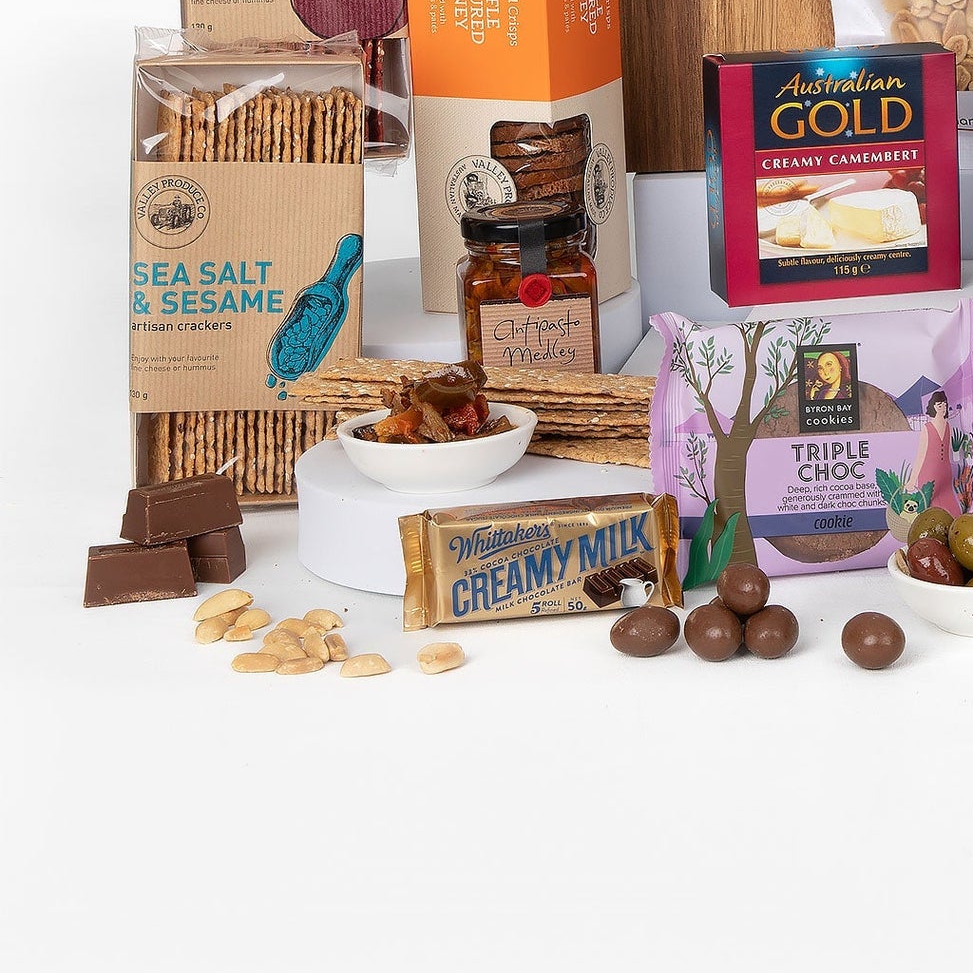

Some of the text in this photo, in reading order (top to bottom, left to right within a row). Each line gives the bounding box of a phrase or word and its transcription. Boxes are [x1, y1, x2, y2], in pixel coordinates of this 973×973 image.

[439, 5, 447, 25] with
[506, 6, 520, 47] Crisps
[775, 67, 906, 99] Australian
[770, 96, 913, 141] GOLD
[761, 149, 919, 171] CREAMY CAMEMBERT
[471, 159, 509, 184] VALLEY
[137, 178, 205, 220] VALLEY PRODUCE
[778, 251, 911, 268] Subtle flavour, deliciously creamy centre.
[133, 261, 273, 287] SEA SALT
[833, 265, 859, 277] 115 g
[132, 289, 284, 315] & SESAME
[131, 319, 232, 332] artisan crackers
[131, 353, 220, 364] Enjoy with your favourite
[502, 339, 576, 367] Medley
[805, 404, 852, 414] BYRON BAY
[806, 414, 853, 426] cookies
[791, 440, 870, 462] TRIPLE
[797, 461, 866, 483] CHOC
[782, 490, 882, 504] generously crammed with
[813, 483, 828, 492] rich
[829, 483, 854, 491] cocoa
[855, 482, 877, 490] base,
[777, 502, 799, 512] white
[800, 502, 816, 511] and
[817, 501, 836, 510] dark
[836, 500, 857, 509] choc
[813, 514, 854, 529] cookie
[448, 522, 551, 564] Whittaker's
[480, 537, 559, 571] COCOA CHOCOLATE
[451, 511, 655, 618] CREAMY MILK
[495, 576, 583, 613] MILK CHOCOLATE BAR
[530, 601, 542, 615] 5
[541, 599, 562, 607] ROLL
